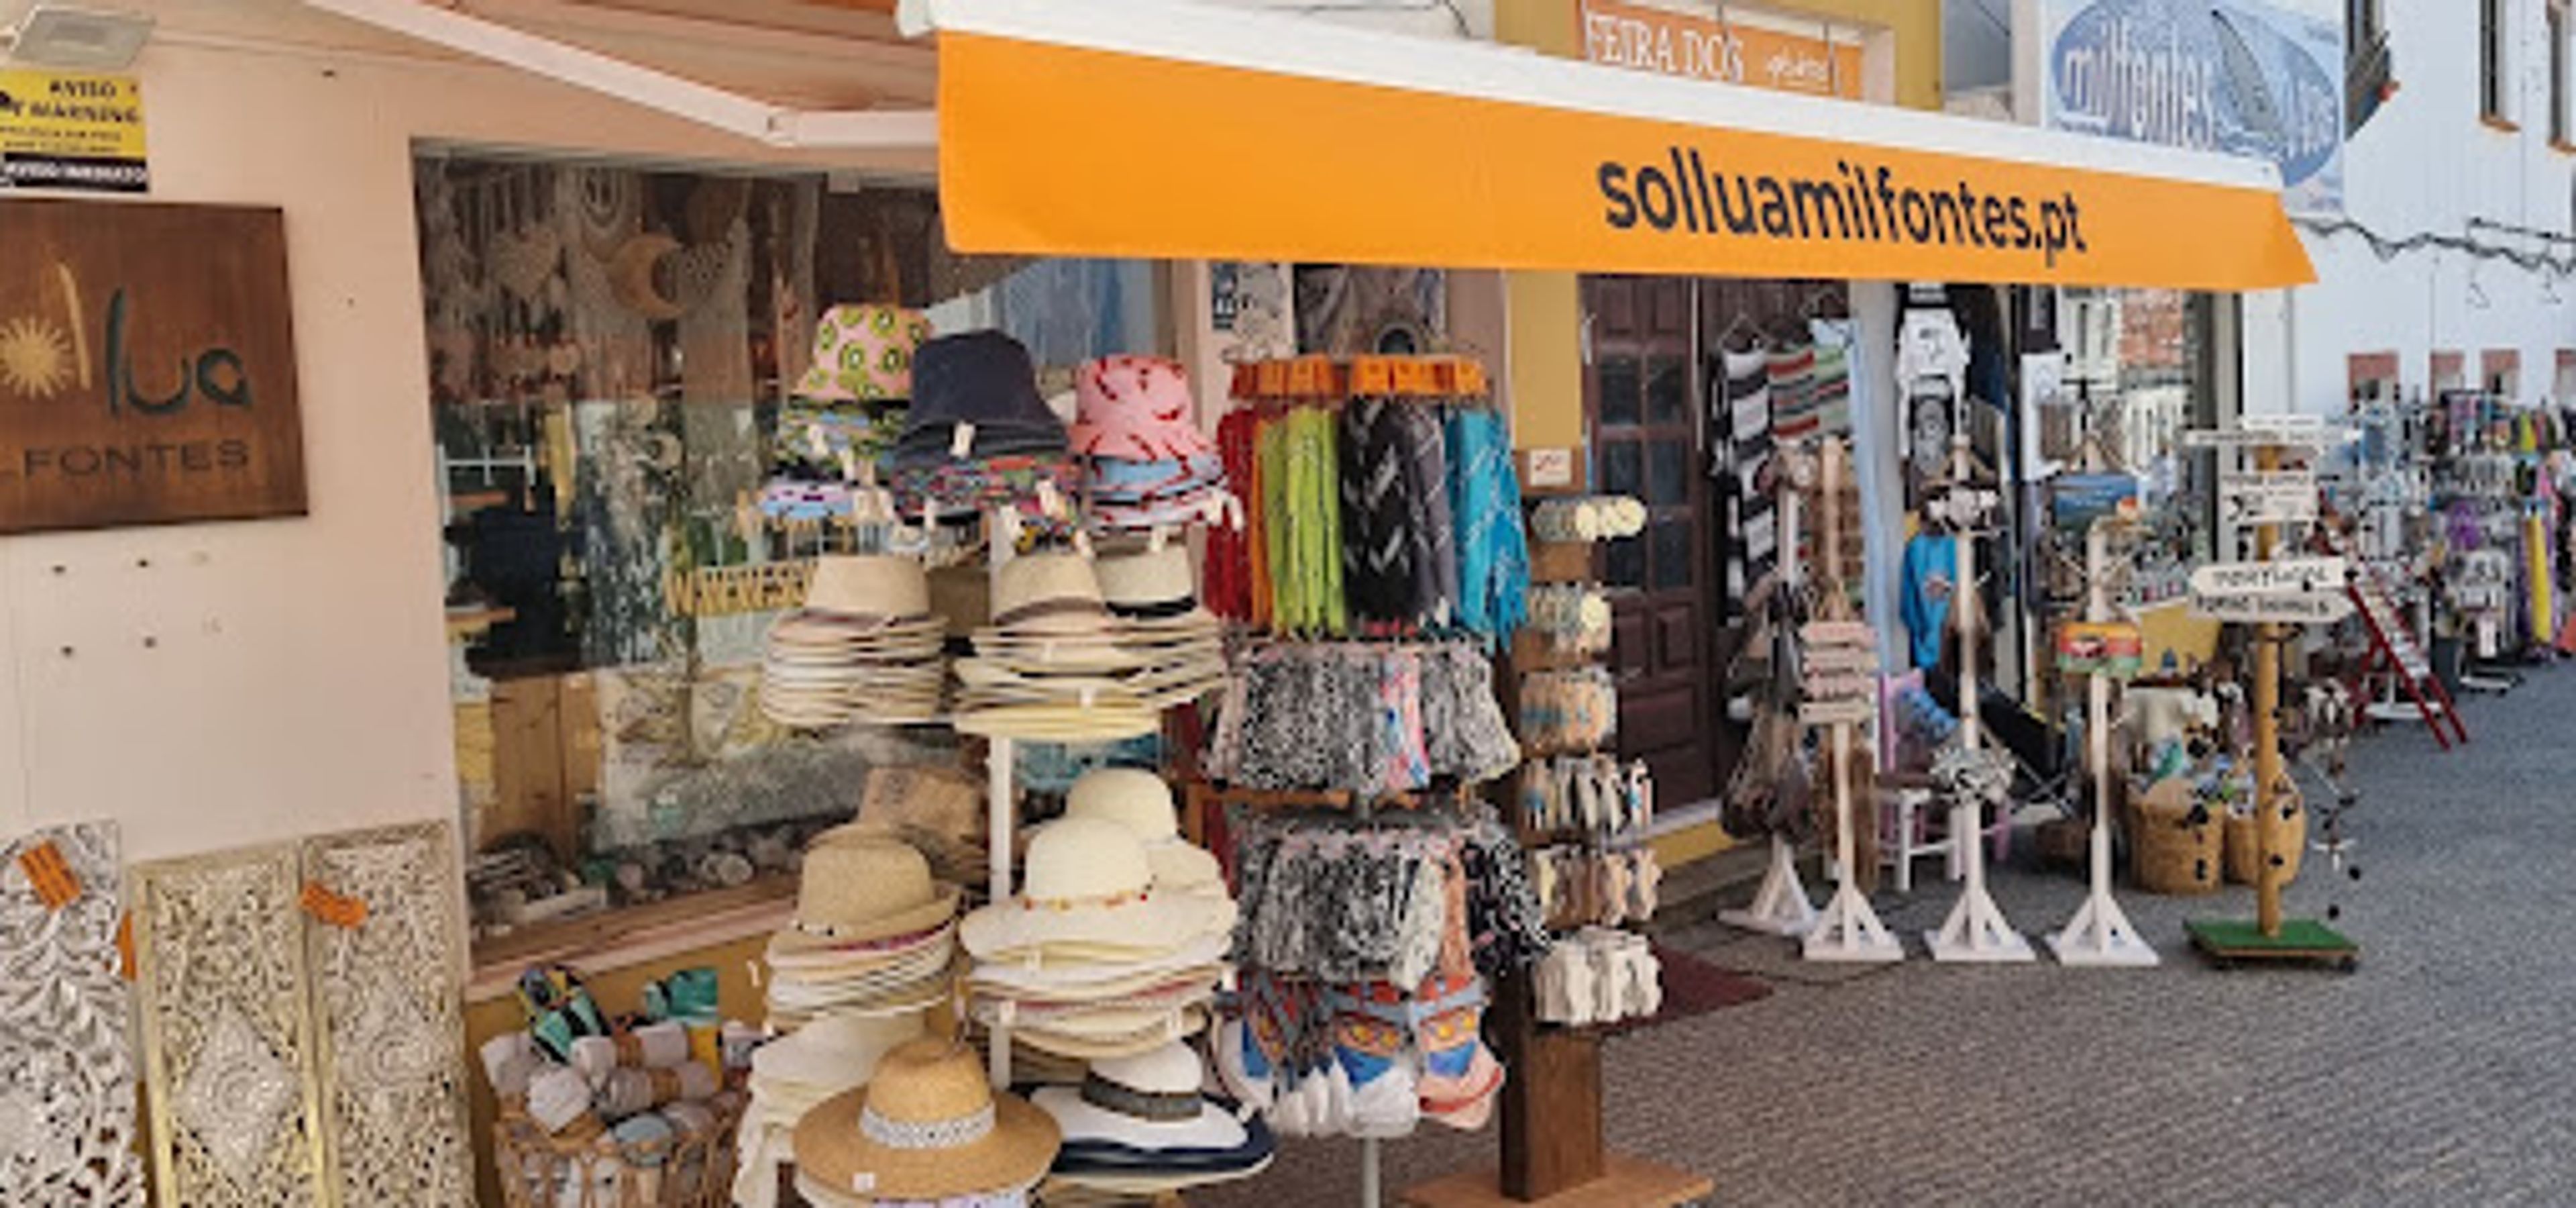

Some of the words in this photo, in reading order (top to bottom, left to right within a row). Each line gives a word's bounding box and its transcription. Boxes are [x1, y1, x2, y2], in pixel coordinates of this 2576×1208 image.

[1585, 10, 1677, 73] FEIRA
[1597, 146, 2086, 267] solluamilfontes.pt
[105, 287, 253, 421] lua
